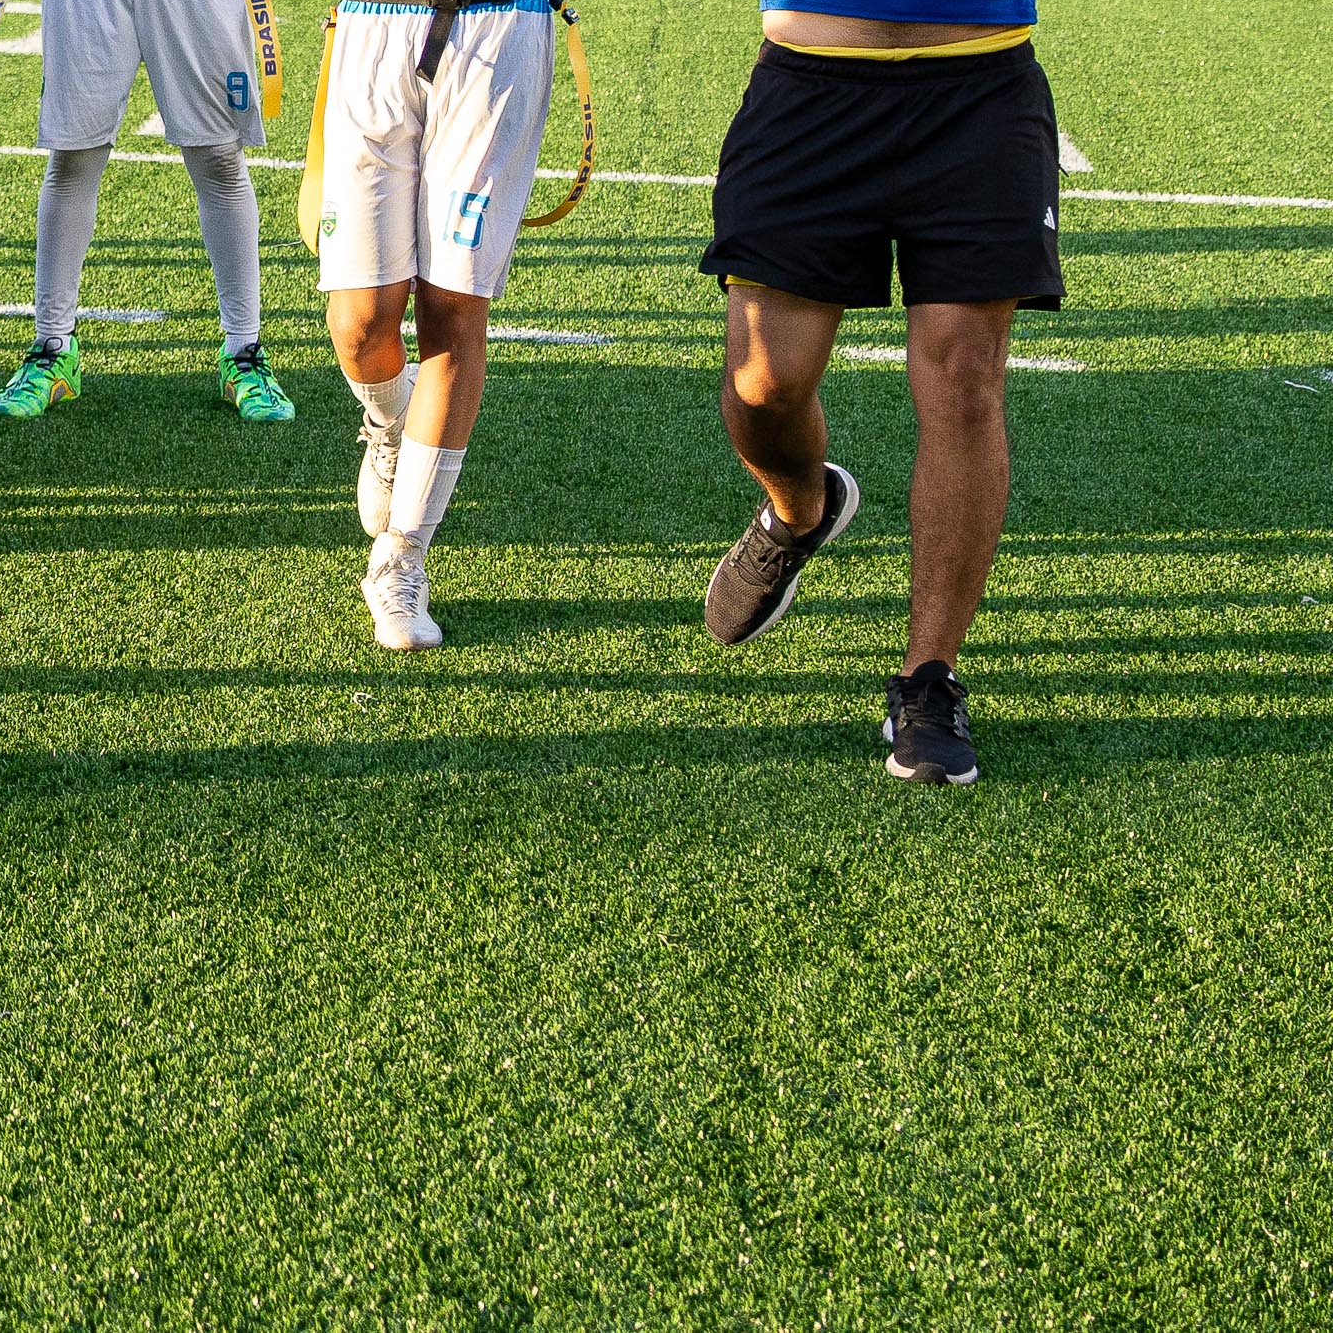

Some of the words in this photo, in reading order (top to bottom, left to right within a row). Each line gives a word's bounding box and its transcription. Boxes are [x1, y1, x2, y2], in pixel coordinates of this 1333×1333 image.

[226, 71, 250, 113] 9
[567, 94, 594, 202] BRASIL
[443, 189, 491, 251] 15
